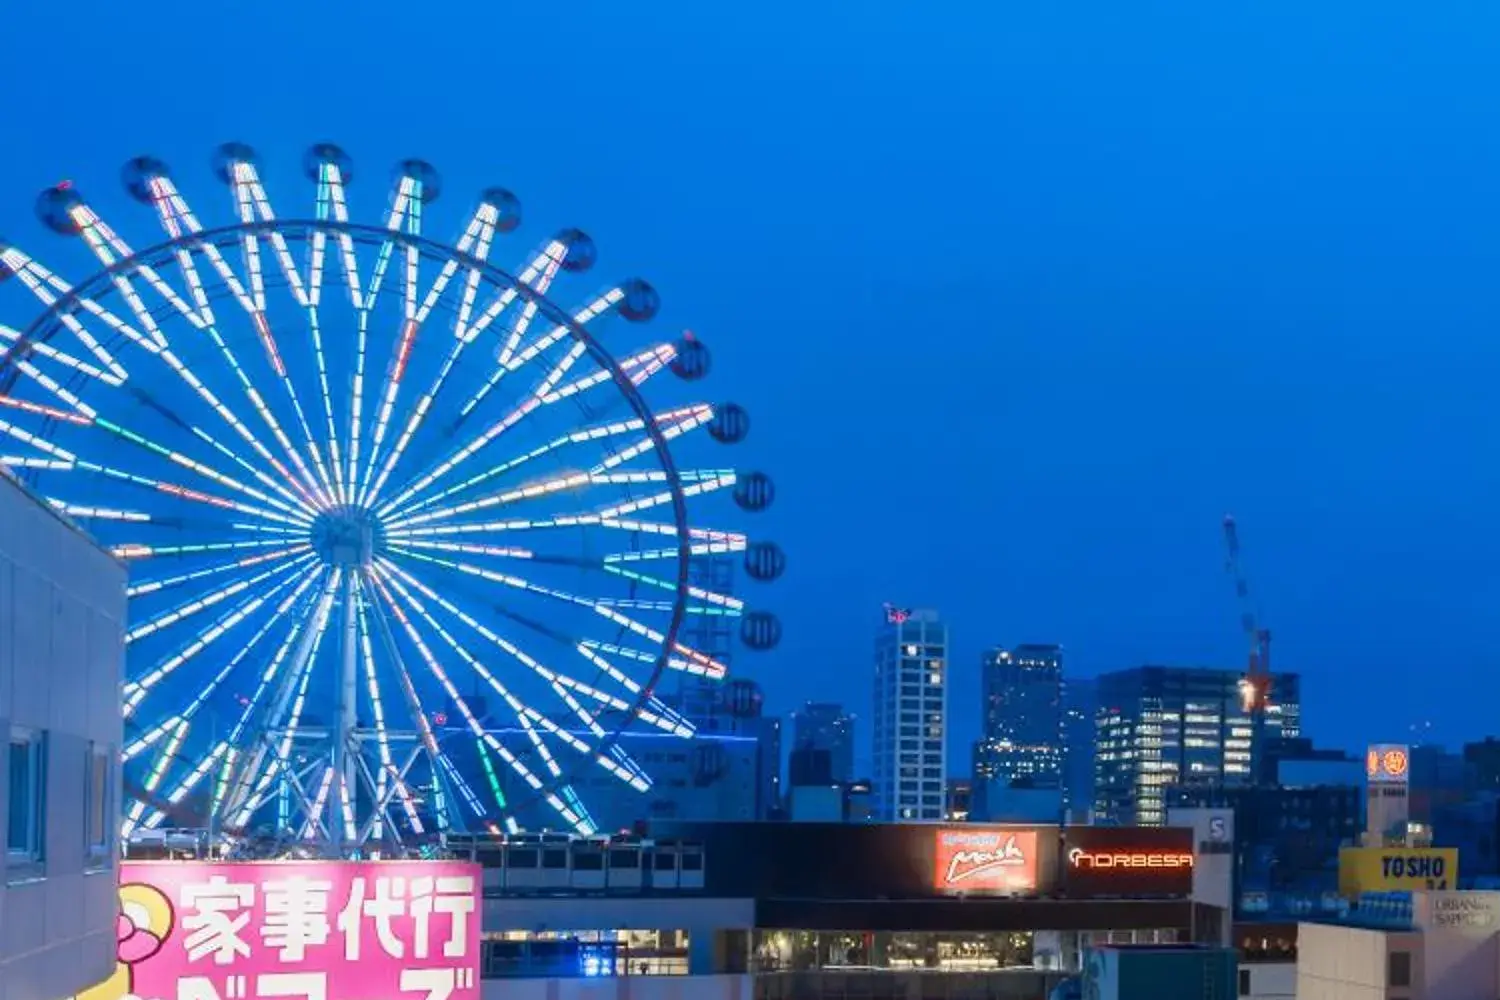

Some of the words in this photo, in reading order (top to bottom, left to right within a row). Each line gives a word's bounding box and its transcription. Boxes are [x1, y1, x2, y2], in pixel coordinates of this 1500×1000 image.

[1381, 855, 1444, 878] TOSHO
[180, 876, 475, 964] 家事代行
